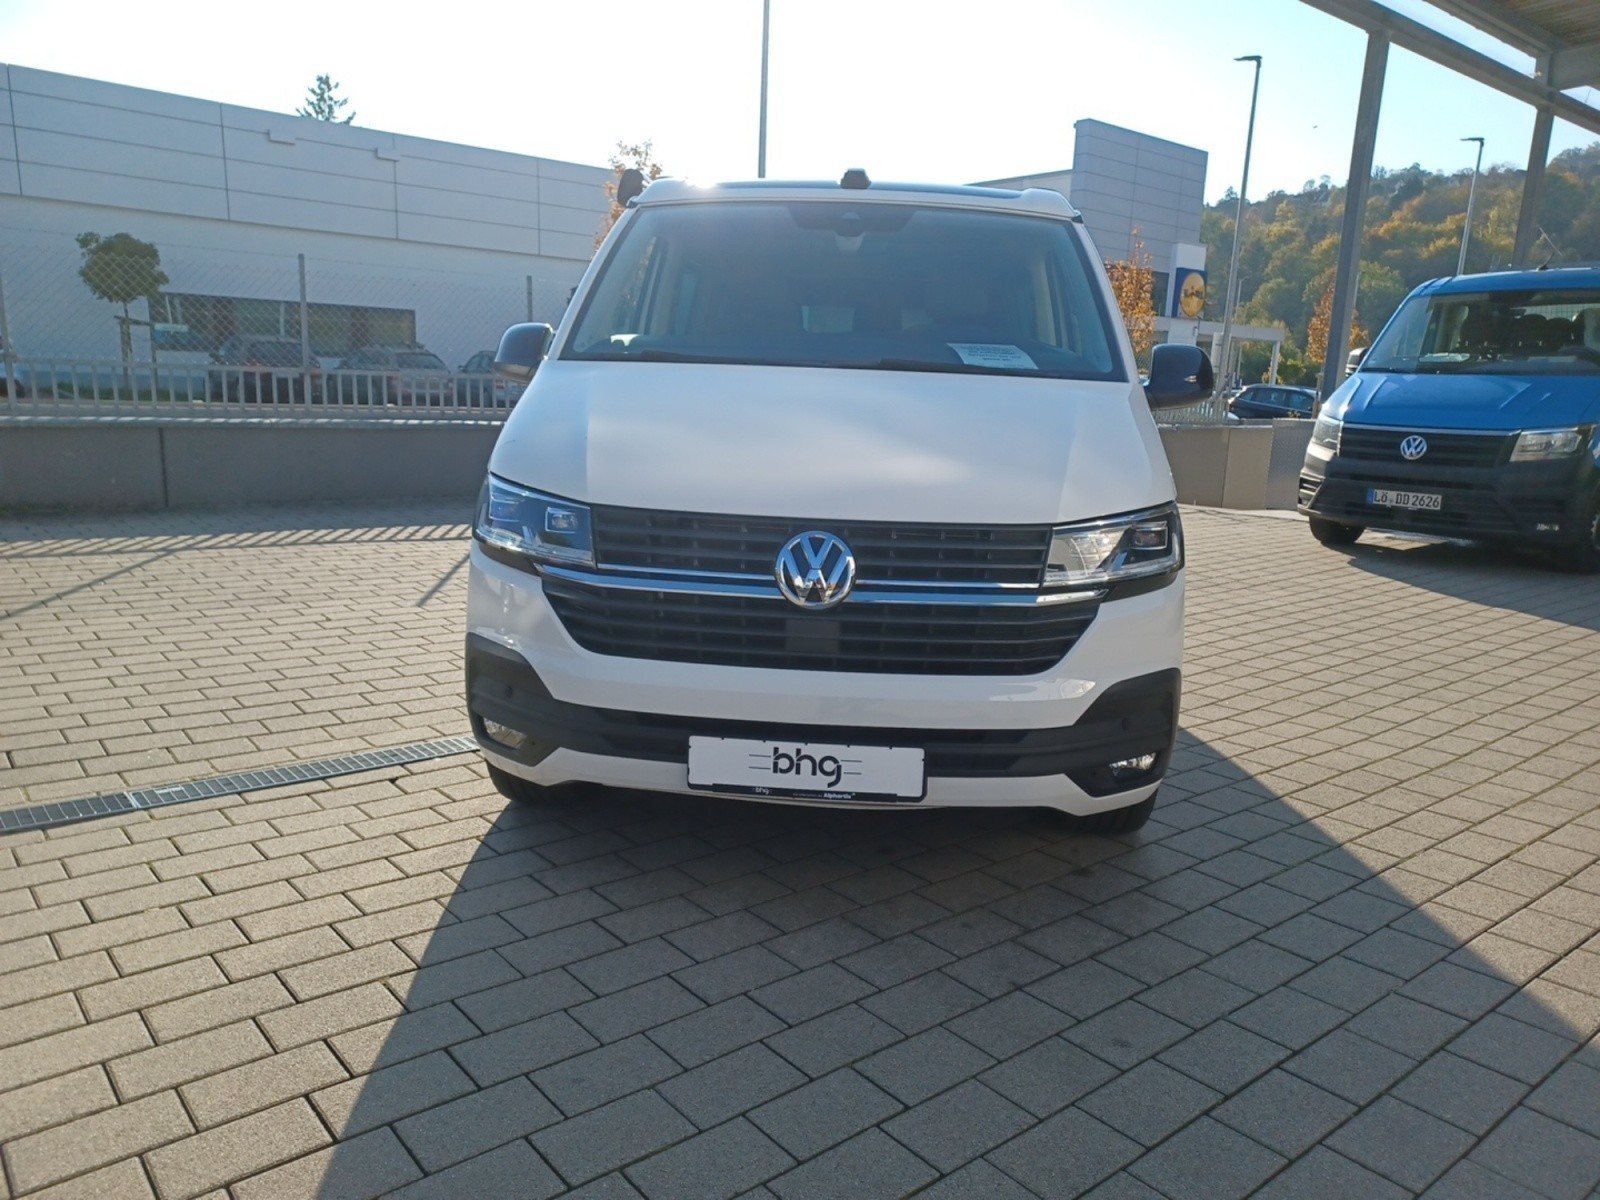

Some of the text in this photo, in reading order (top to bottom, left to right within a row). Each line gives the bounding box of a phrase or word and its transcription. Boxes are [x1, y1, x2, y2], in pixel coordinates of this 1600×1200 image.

[1374, 490, 1440, 508] LÖ DD 2626
[776, 530, 856, 609] VW
[772, 747, 842, 788] bhg
